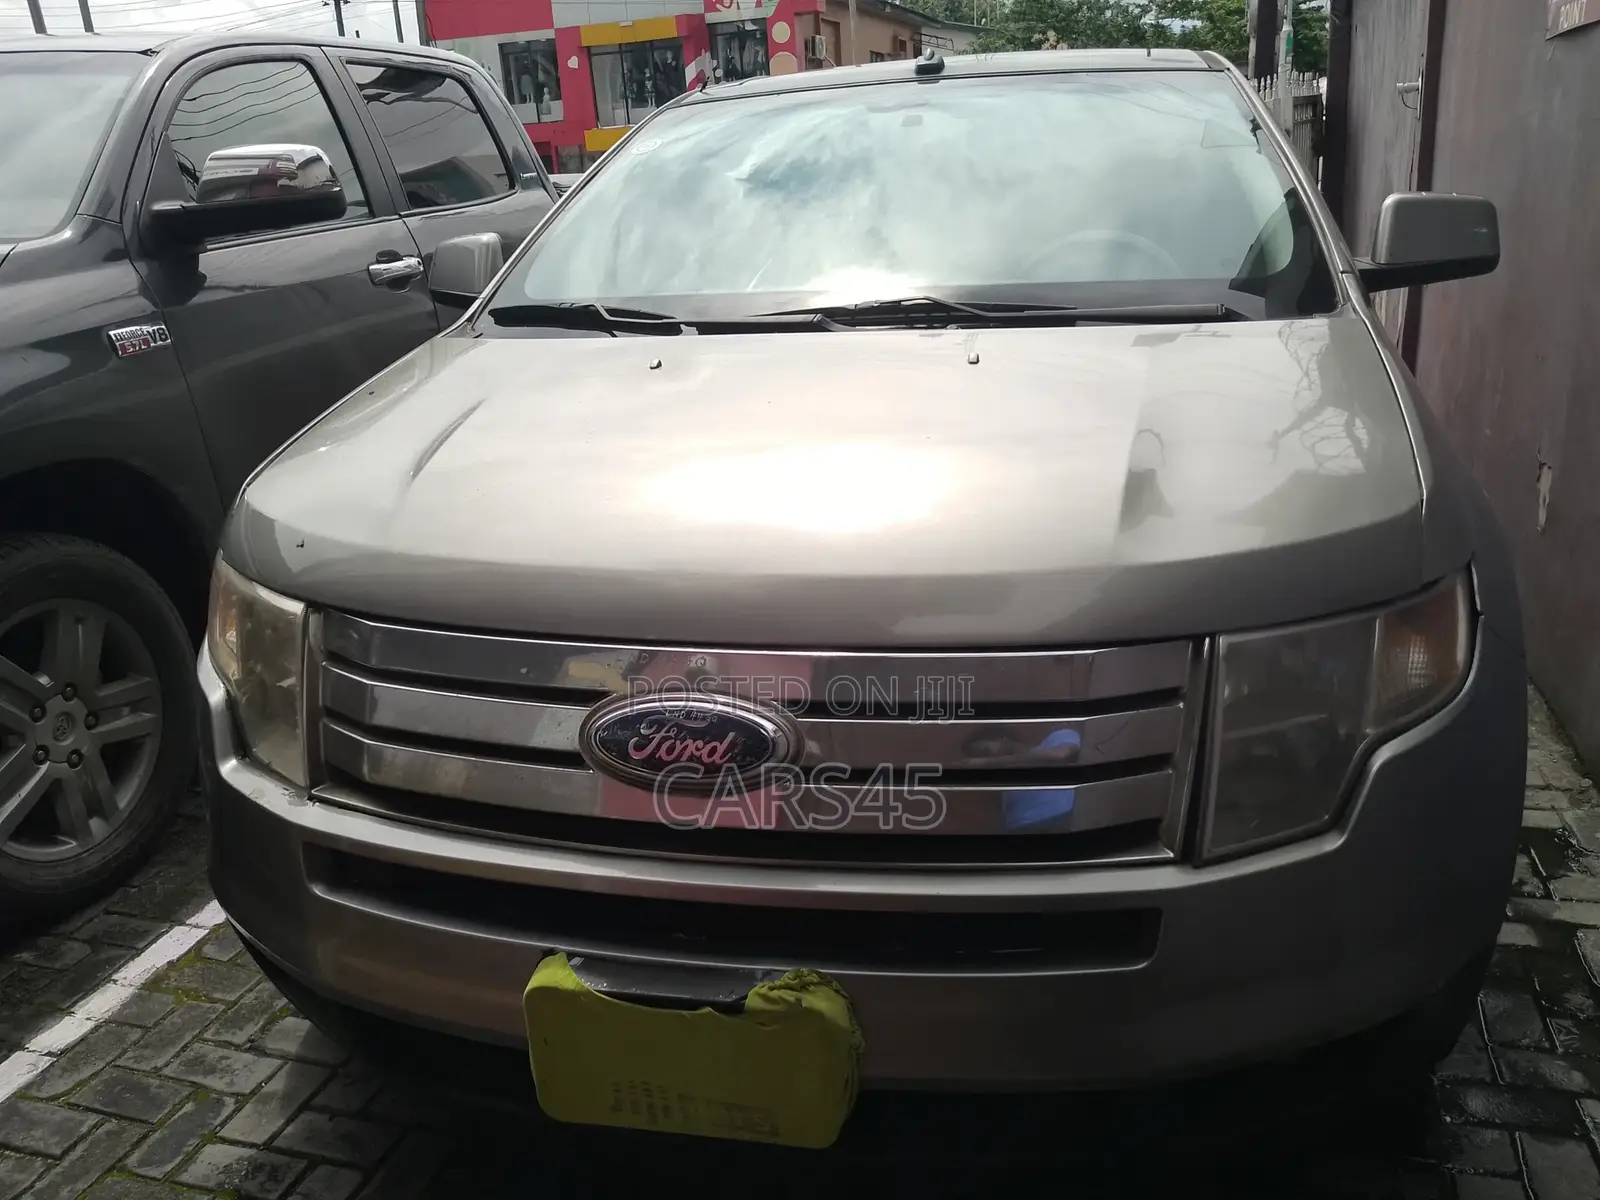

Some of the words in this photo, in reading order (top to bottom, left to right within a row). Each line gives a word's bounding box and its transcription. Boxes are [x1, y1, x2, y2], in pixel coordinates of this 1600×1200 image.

[146, 327, 169, 344] V8
[125, 340, 147, 352] 5.7L
[628, 715, 737, 764] Ford
